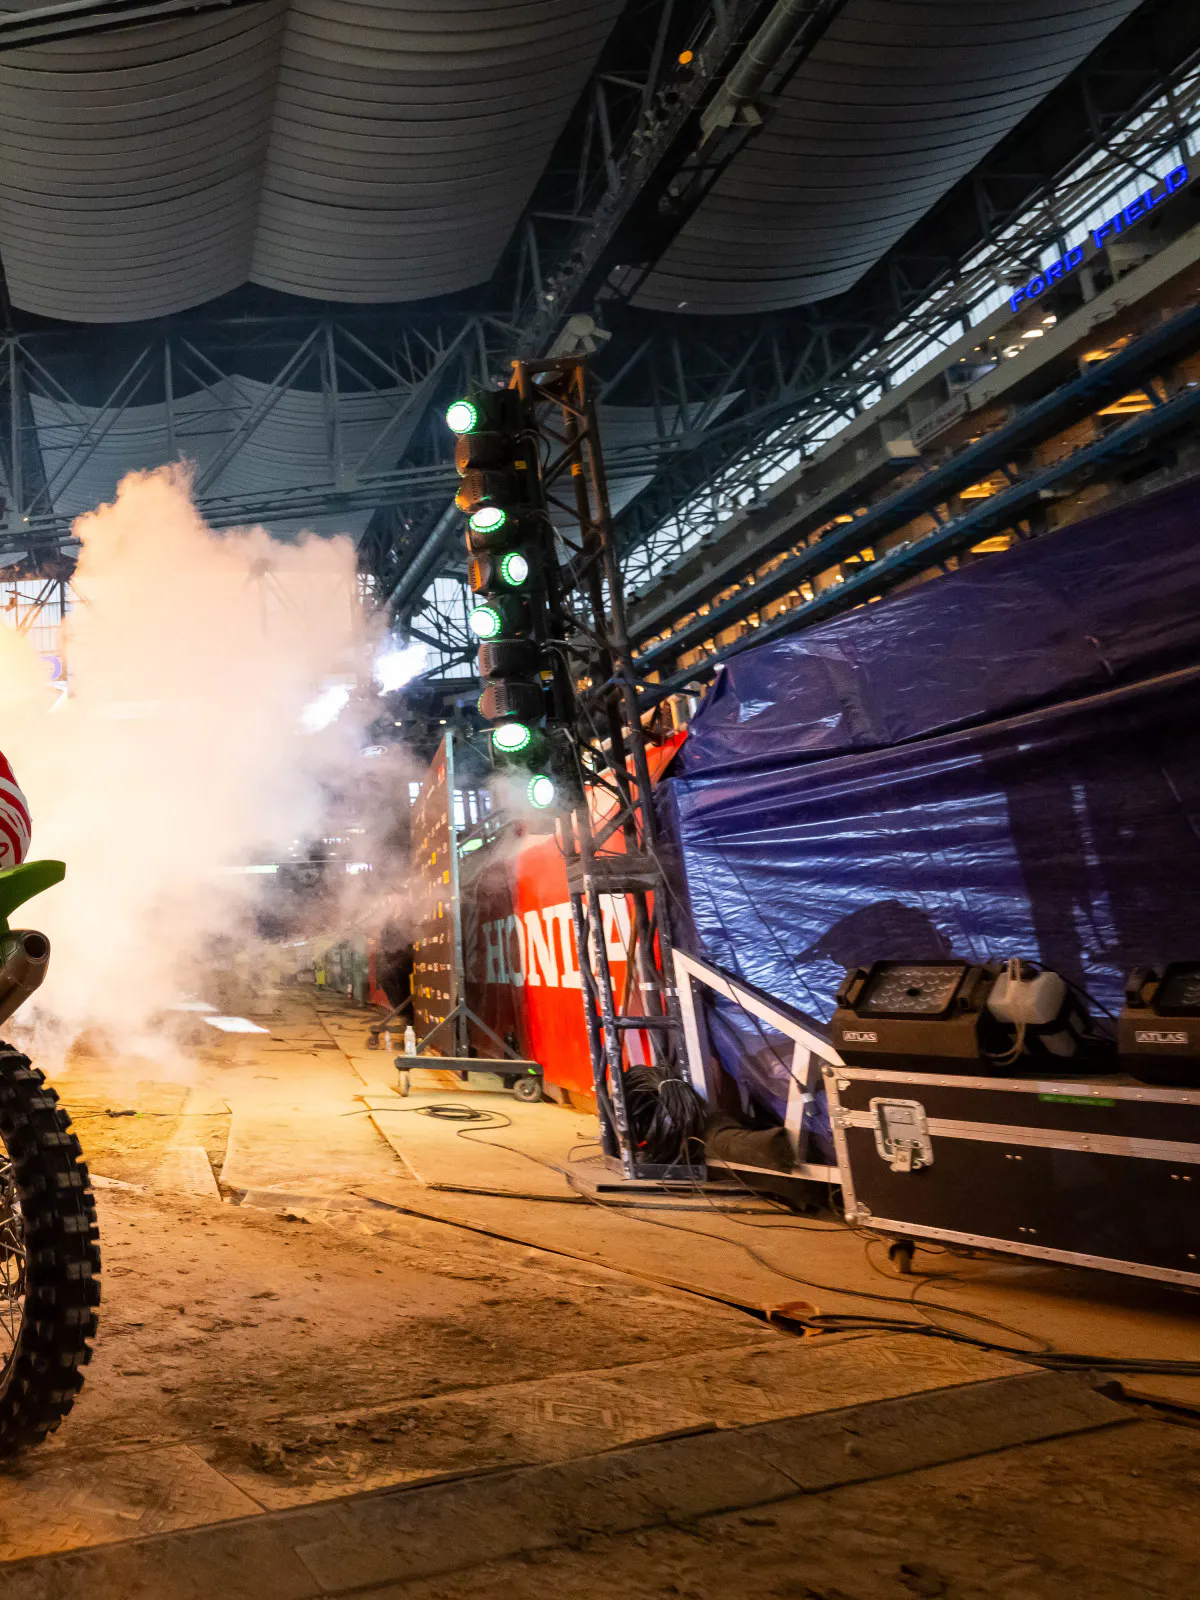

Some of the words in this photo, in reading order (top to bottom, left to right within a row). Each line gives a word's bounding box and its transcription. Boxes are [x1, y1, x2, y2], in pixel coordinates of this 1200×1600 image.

[1009, 245, 1084, 313] FORD
[1092, 163, 1189, 249] FIELD
[844, 1032, 876, 1041] ATLAS
[1138, 1032, 1185, 1042] ATLAS
